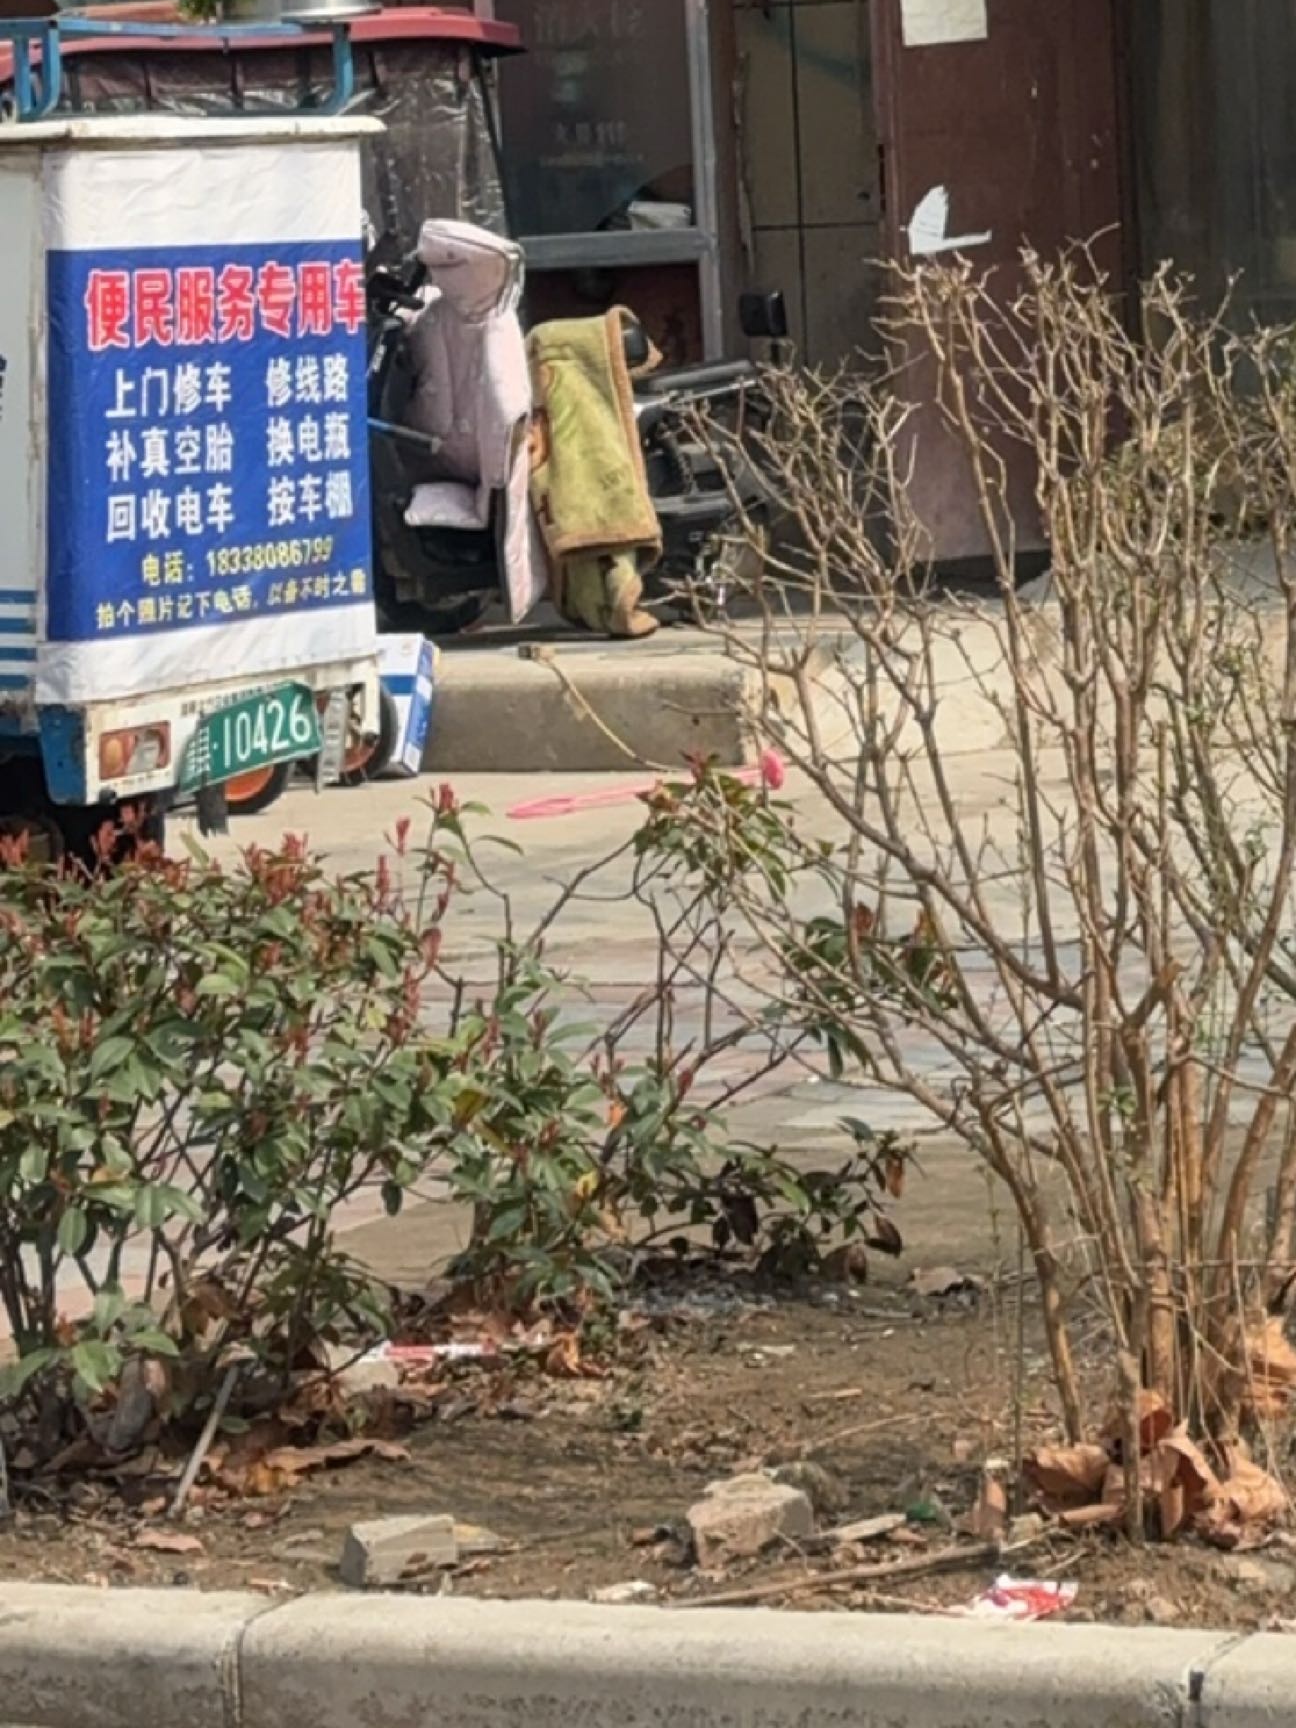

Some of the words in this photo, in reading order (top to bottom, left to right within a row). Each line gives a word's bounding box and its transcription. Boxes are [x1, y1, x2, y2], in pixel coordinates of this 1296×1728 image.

[84, 259, 366, 351] 便民服务专用车
[105, 361, 232, 418] 上门修车
[266, 353, 349, 408] 修线路
[105, 422, 234, 482] 补真空胎
[266, 412, 351, 468] 换电瓶
[106, 481, 235, 542] 回收电车
[222, 694, 311, 770] 10426
